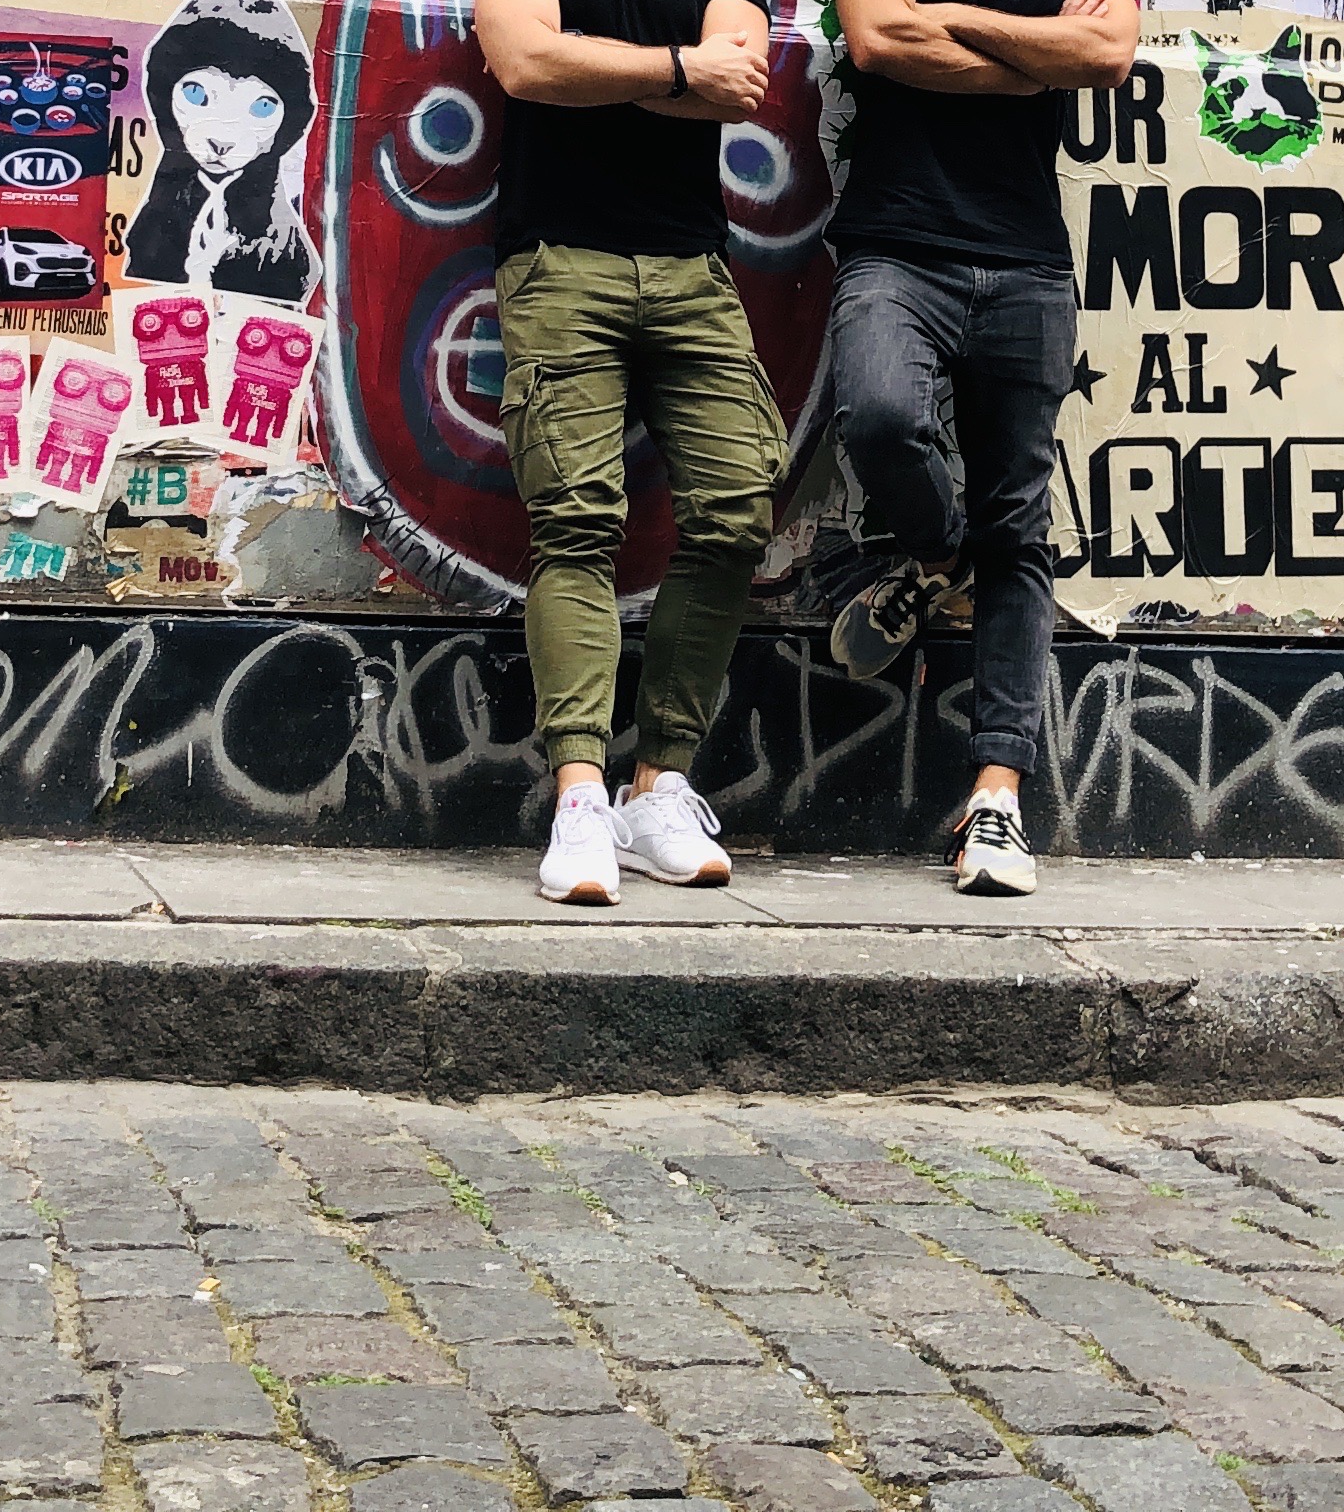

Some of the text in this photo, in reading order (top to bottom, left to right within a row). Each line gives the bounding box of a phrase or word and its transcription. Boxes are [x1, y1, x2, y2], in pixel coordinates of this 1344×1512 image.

[11, 155, 69, 184] KIA
[32, 307, 109, 337] PETRUSHAUS
[1131, 332, 1227, 414] AL
